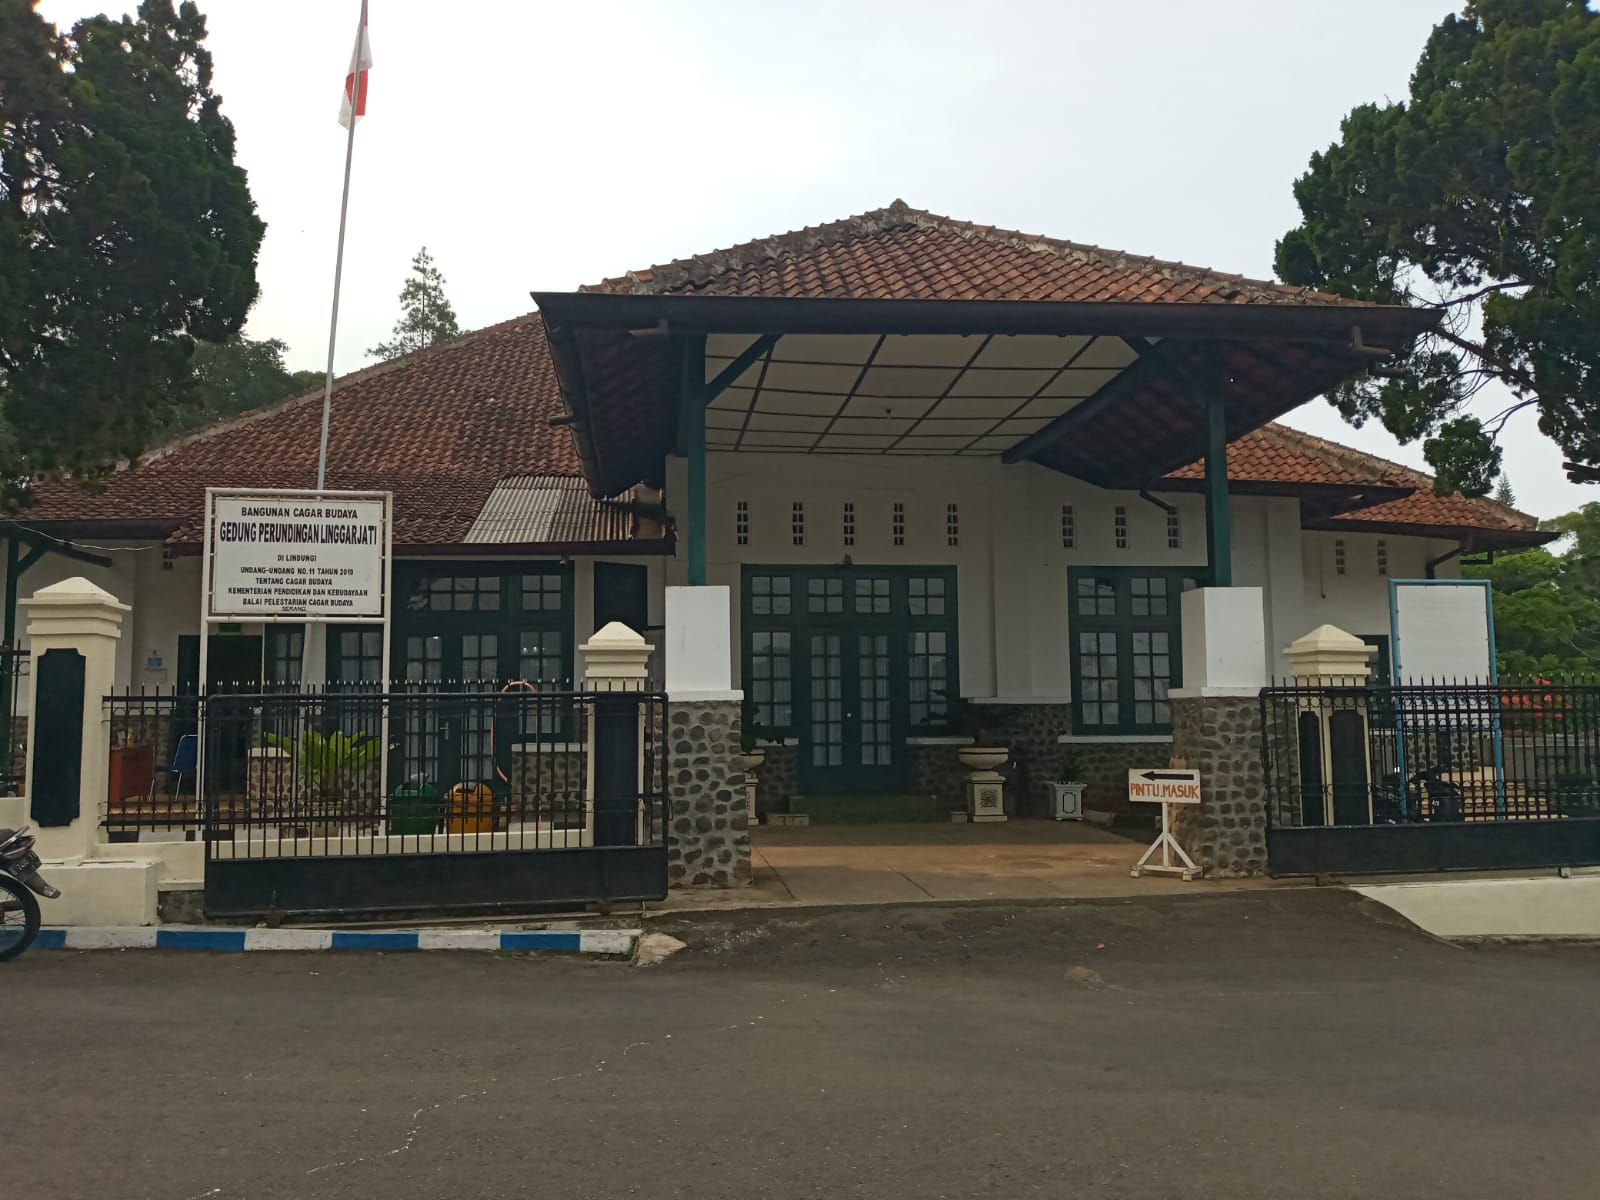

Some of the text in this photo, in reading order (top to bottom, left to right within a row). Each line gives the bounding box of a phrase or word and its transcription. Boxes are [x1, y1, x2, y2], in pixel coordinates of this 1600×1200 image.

[241, 507, 358, 519] BANGUNAN CAGAR BUDAYA
[220, 521, 377, 545] GEDUNG PERUNDINGAN LINGGARJATI
[264, 598, 307, 606] PELESTARIAN
[330, 599, 353, 607] BUDAYA
[1130, 783, 1199, 799] PINTU MASUK
